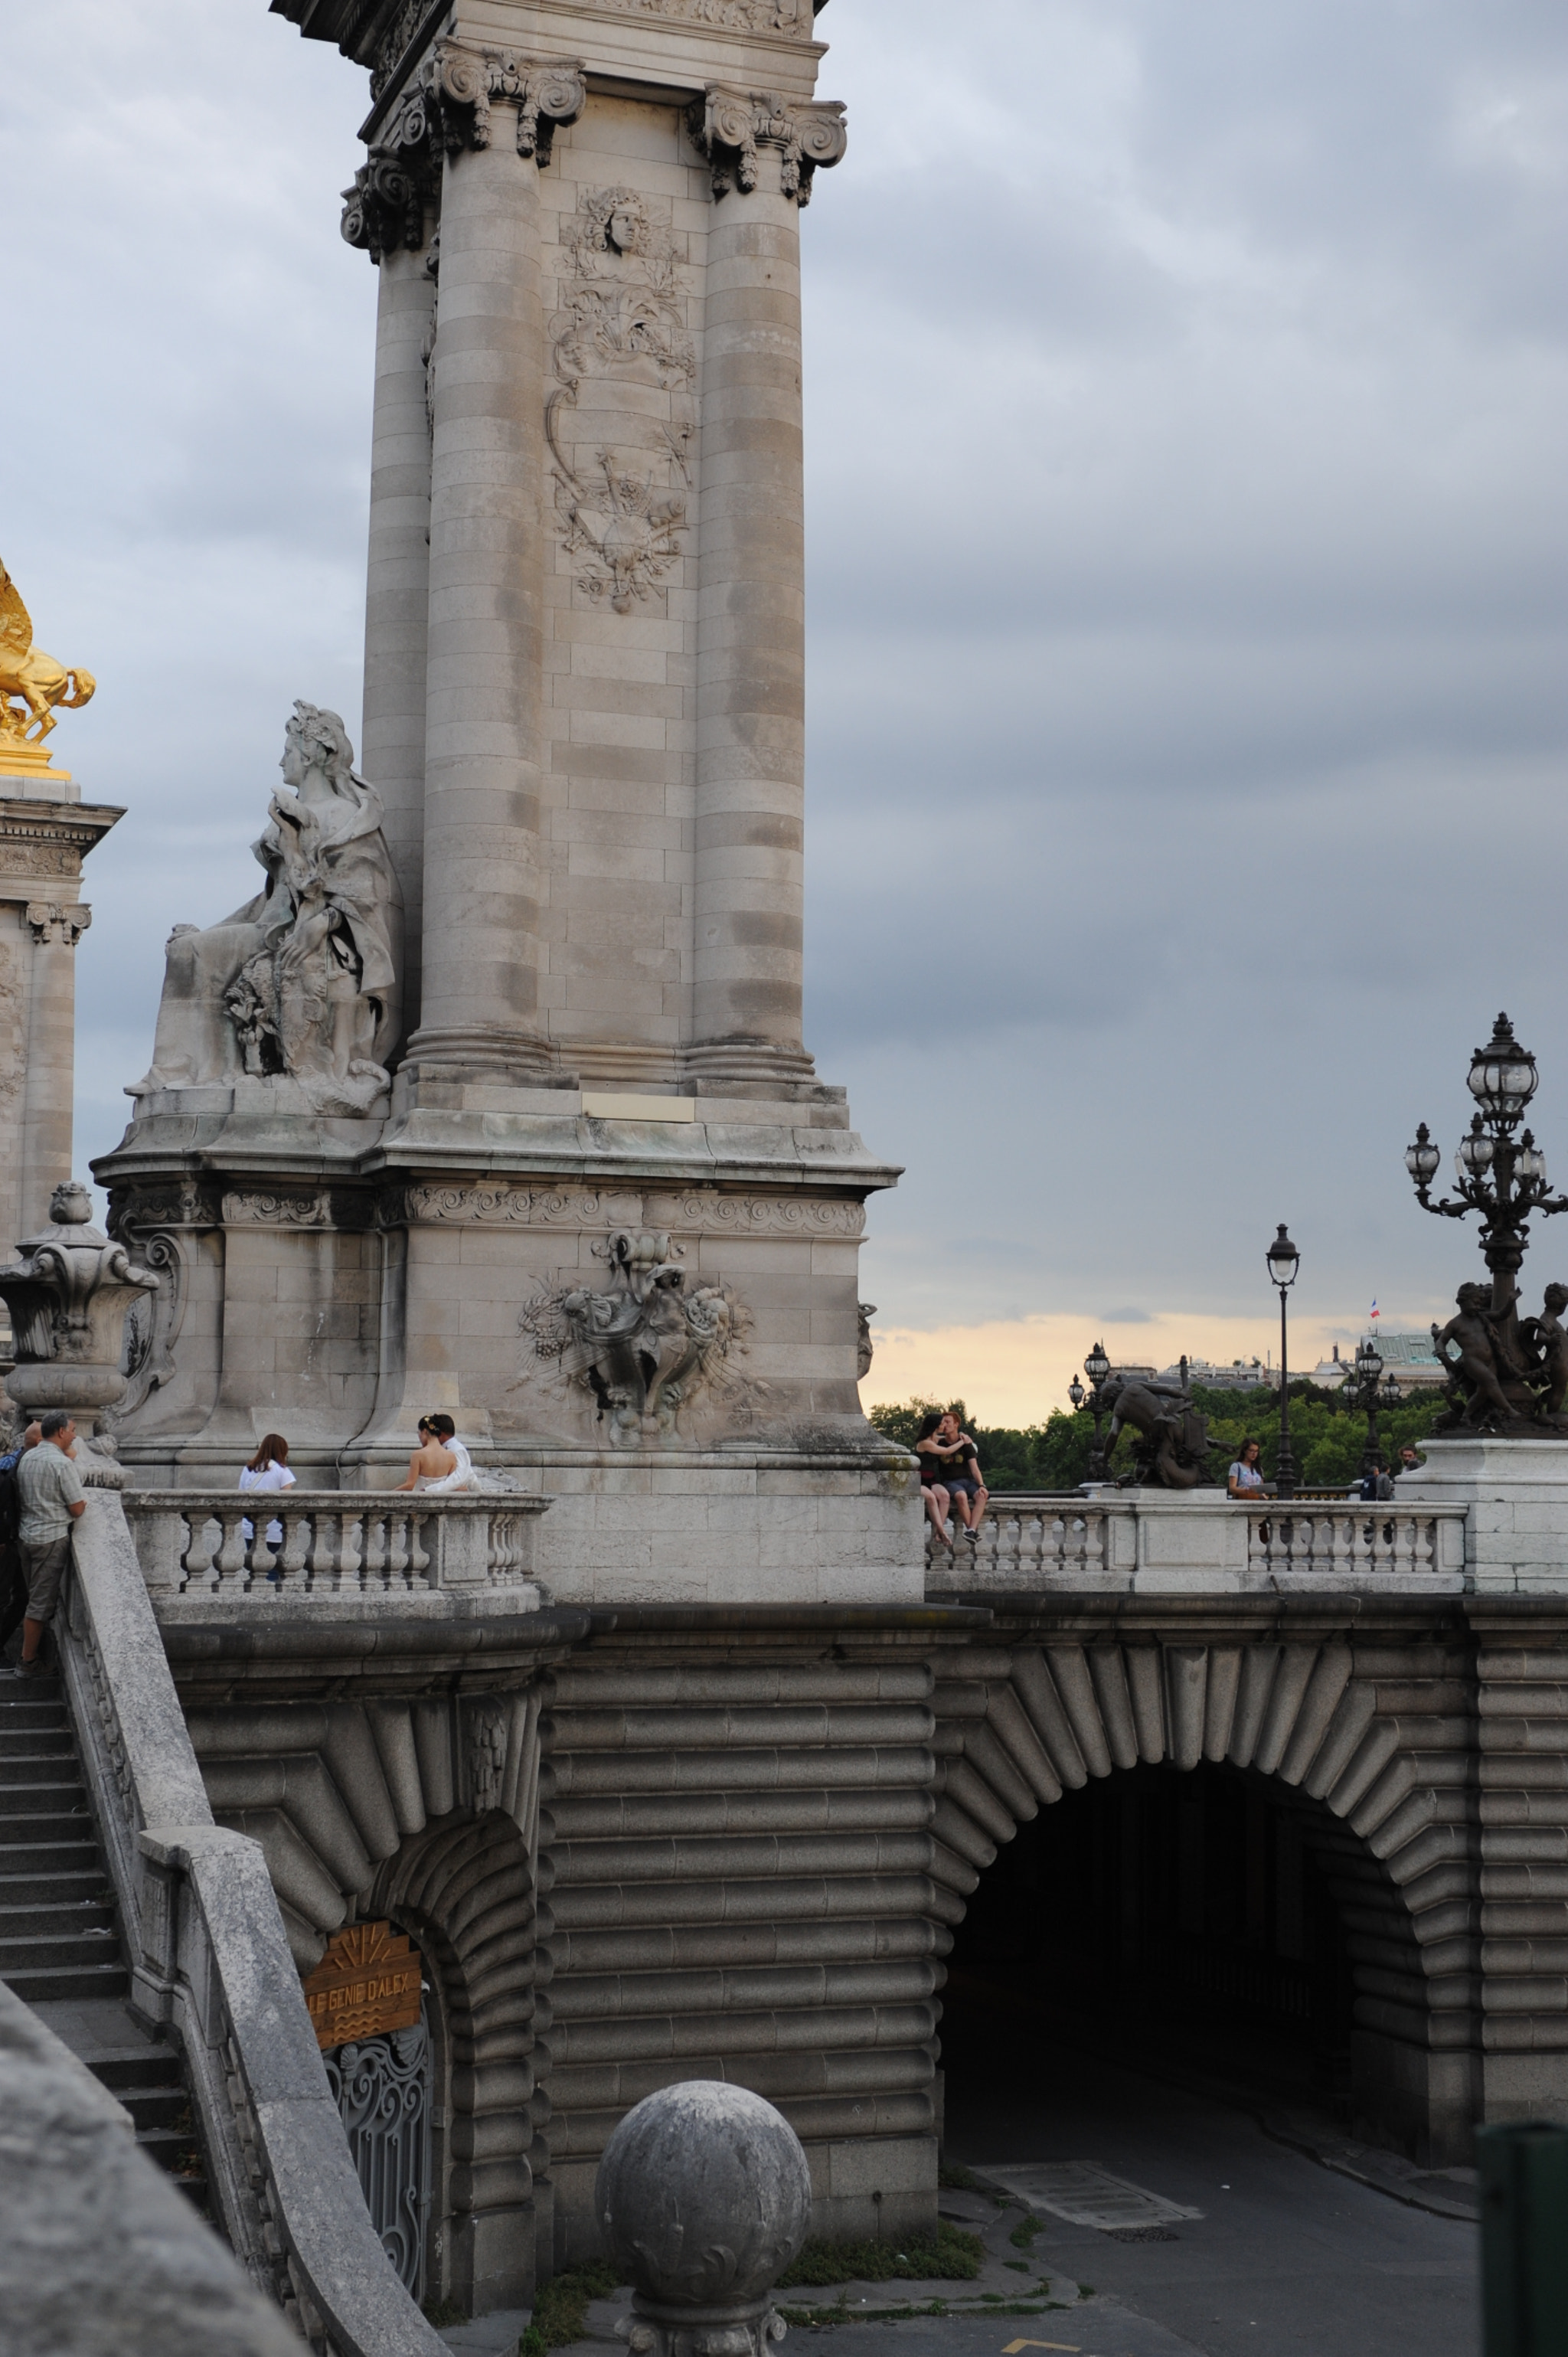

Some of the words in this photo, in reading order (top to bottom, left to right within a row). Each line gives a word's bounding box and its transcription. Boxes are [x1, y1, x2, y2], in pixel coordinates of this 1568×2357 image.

[309, 1993, 326, 2015] LE
[329, 1983, 364, 2011] GENIE
[368, 1972, 410, 2001] D'ALEX
